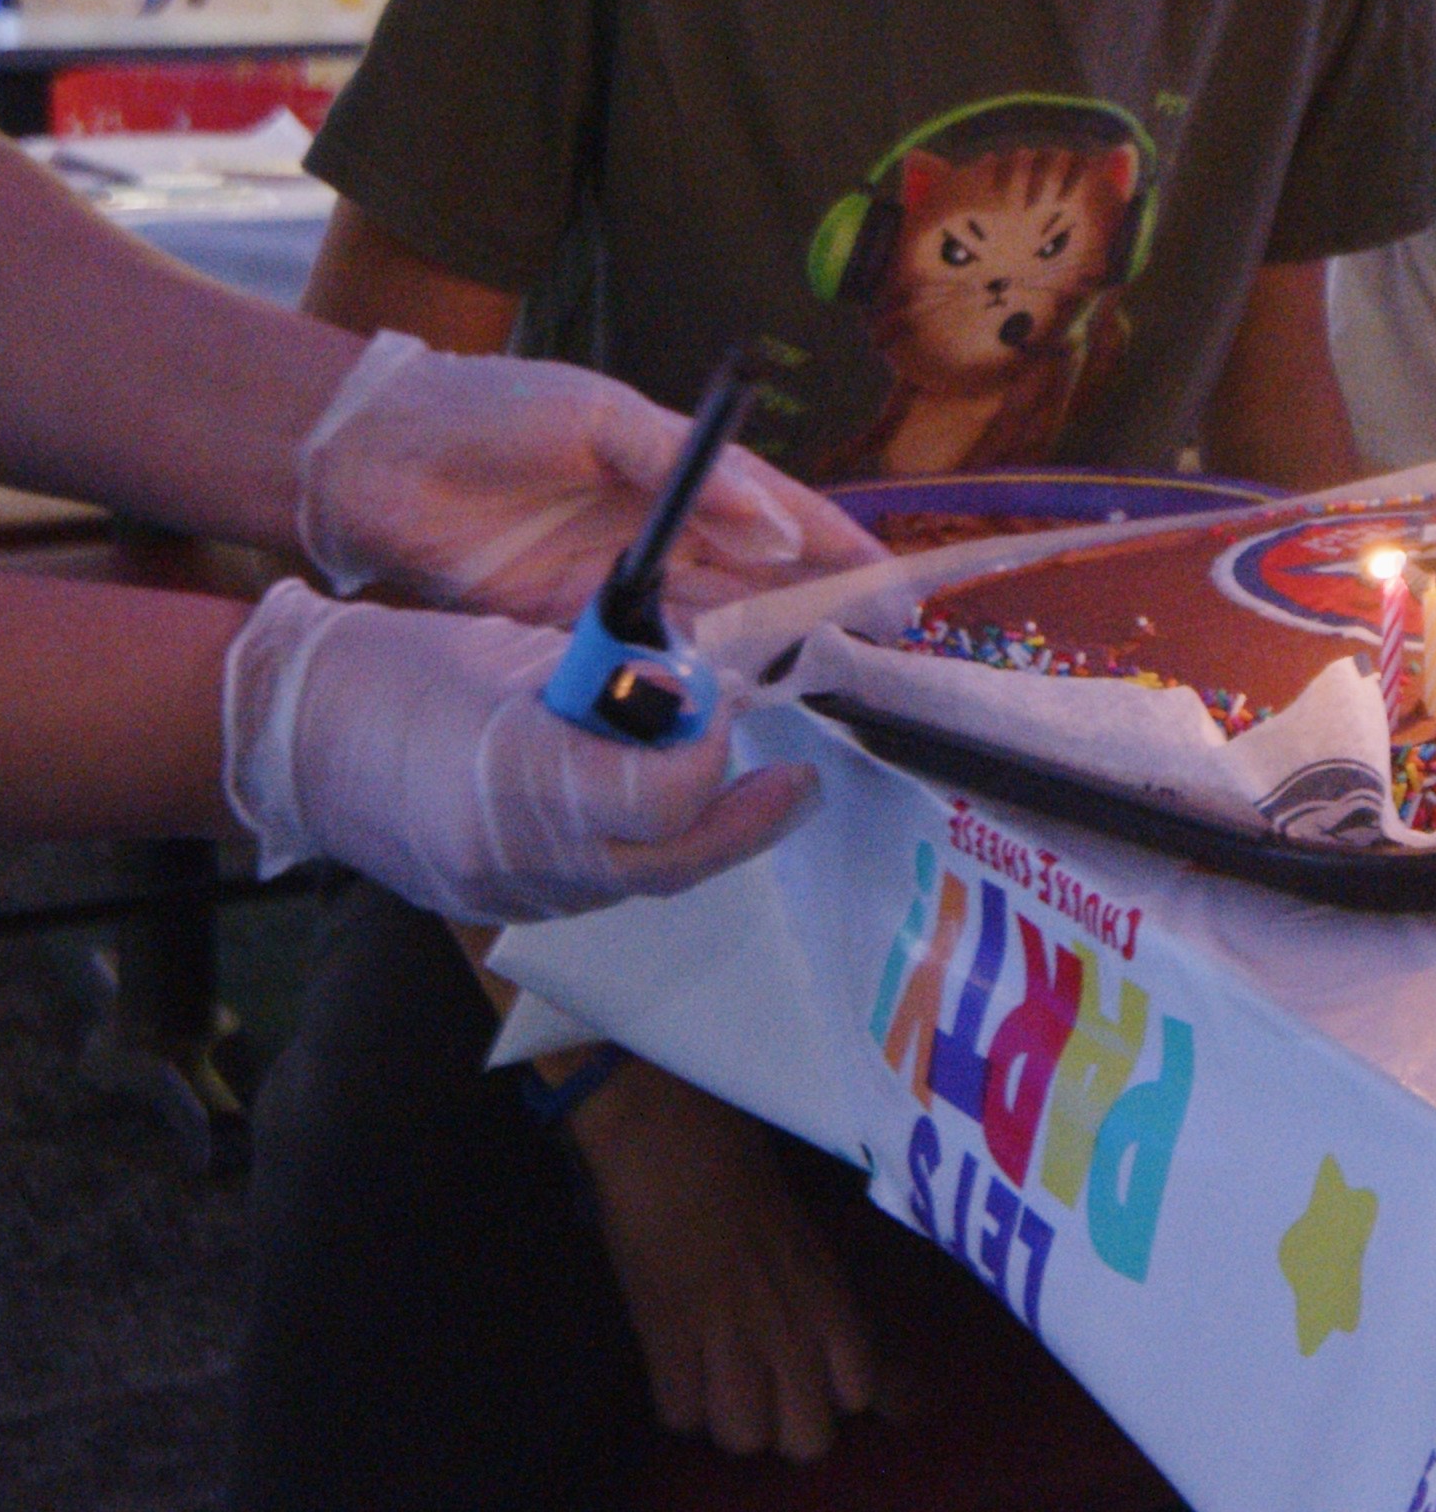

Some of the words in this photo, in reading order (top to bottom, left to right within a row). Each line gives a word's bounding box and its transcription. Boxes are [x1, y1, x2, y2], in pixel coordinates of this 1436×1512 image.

[948, 798, 1033, 889] CHEESE
[1055, 868, 1142, 961] CHUCK
[868, 840, 1196, 1286] PARTY!
